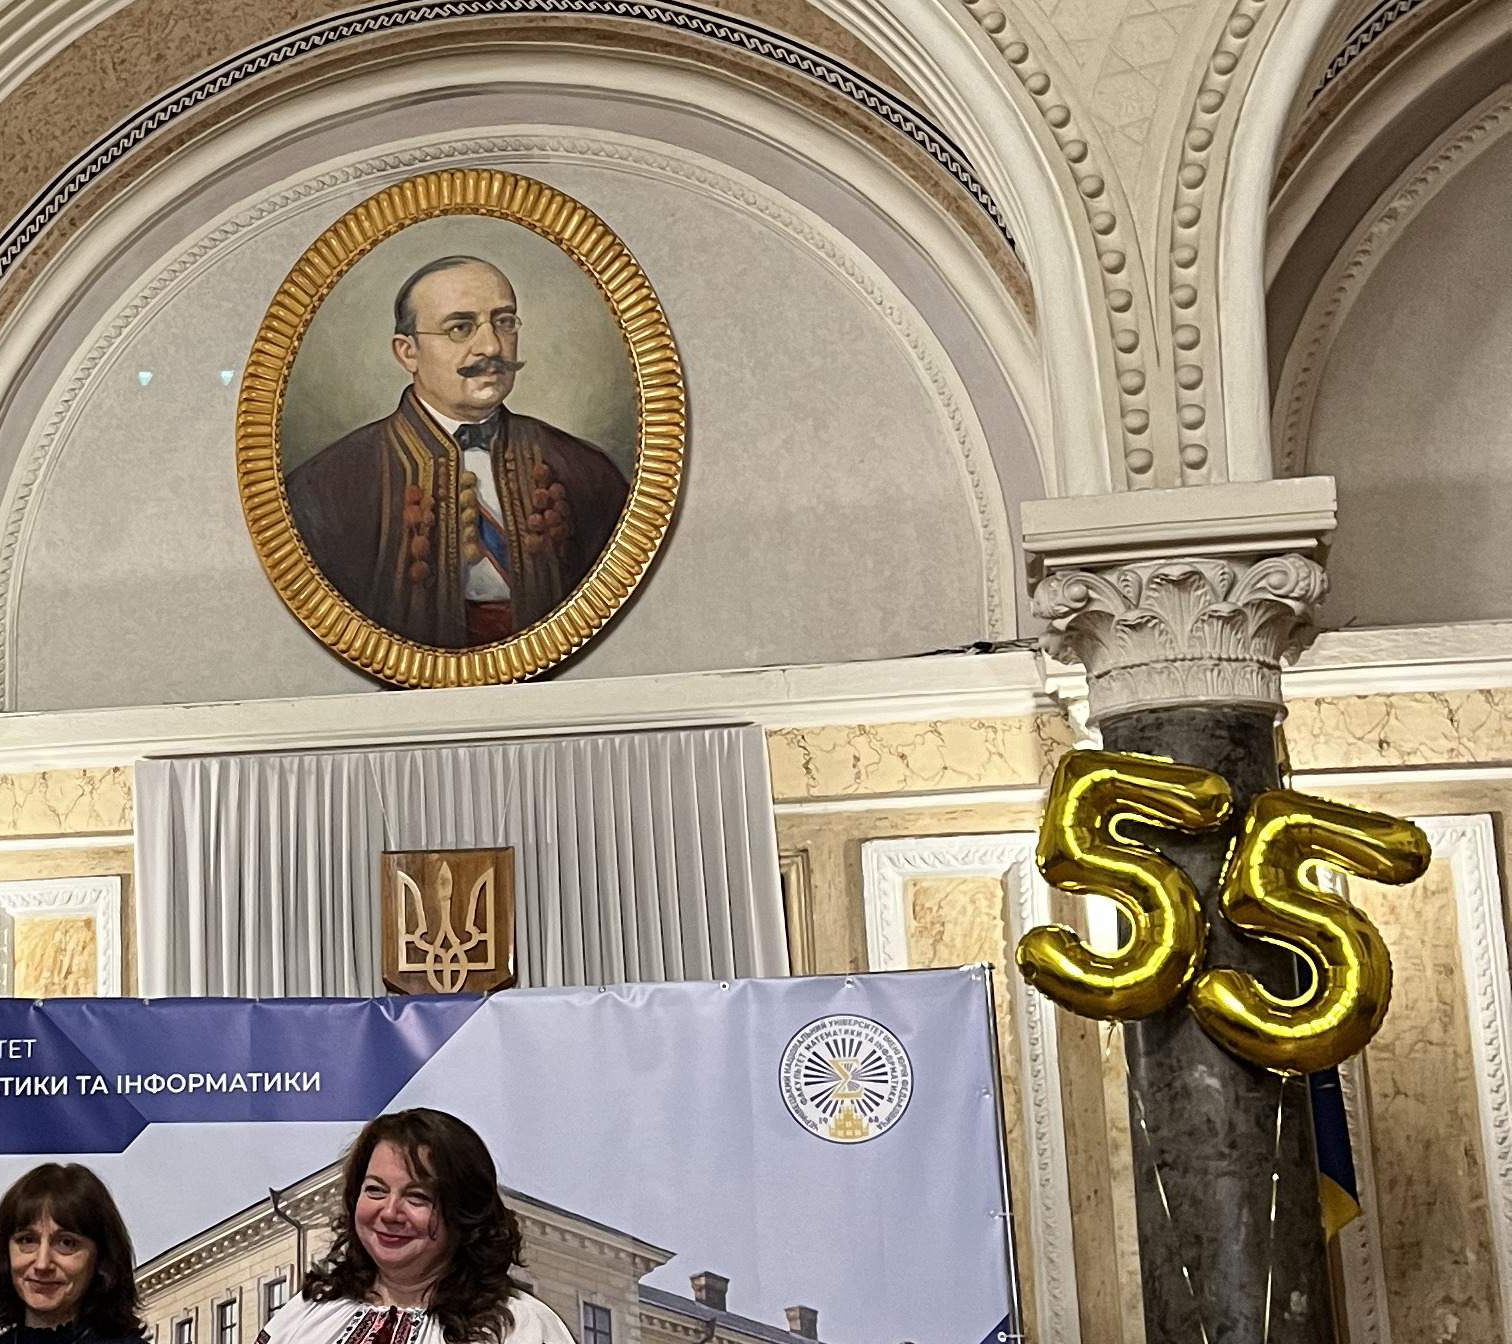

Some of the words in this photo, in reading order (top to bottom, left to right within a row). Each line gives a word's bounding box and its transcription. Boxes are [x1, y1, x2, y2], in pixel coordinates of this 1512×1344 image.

[1017, 748, 1431, 1075] 55
[76, 1075, 109, 1095] ТА
[116, 1071, 321, 1094] ІНФОРМАТИКИ
